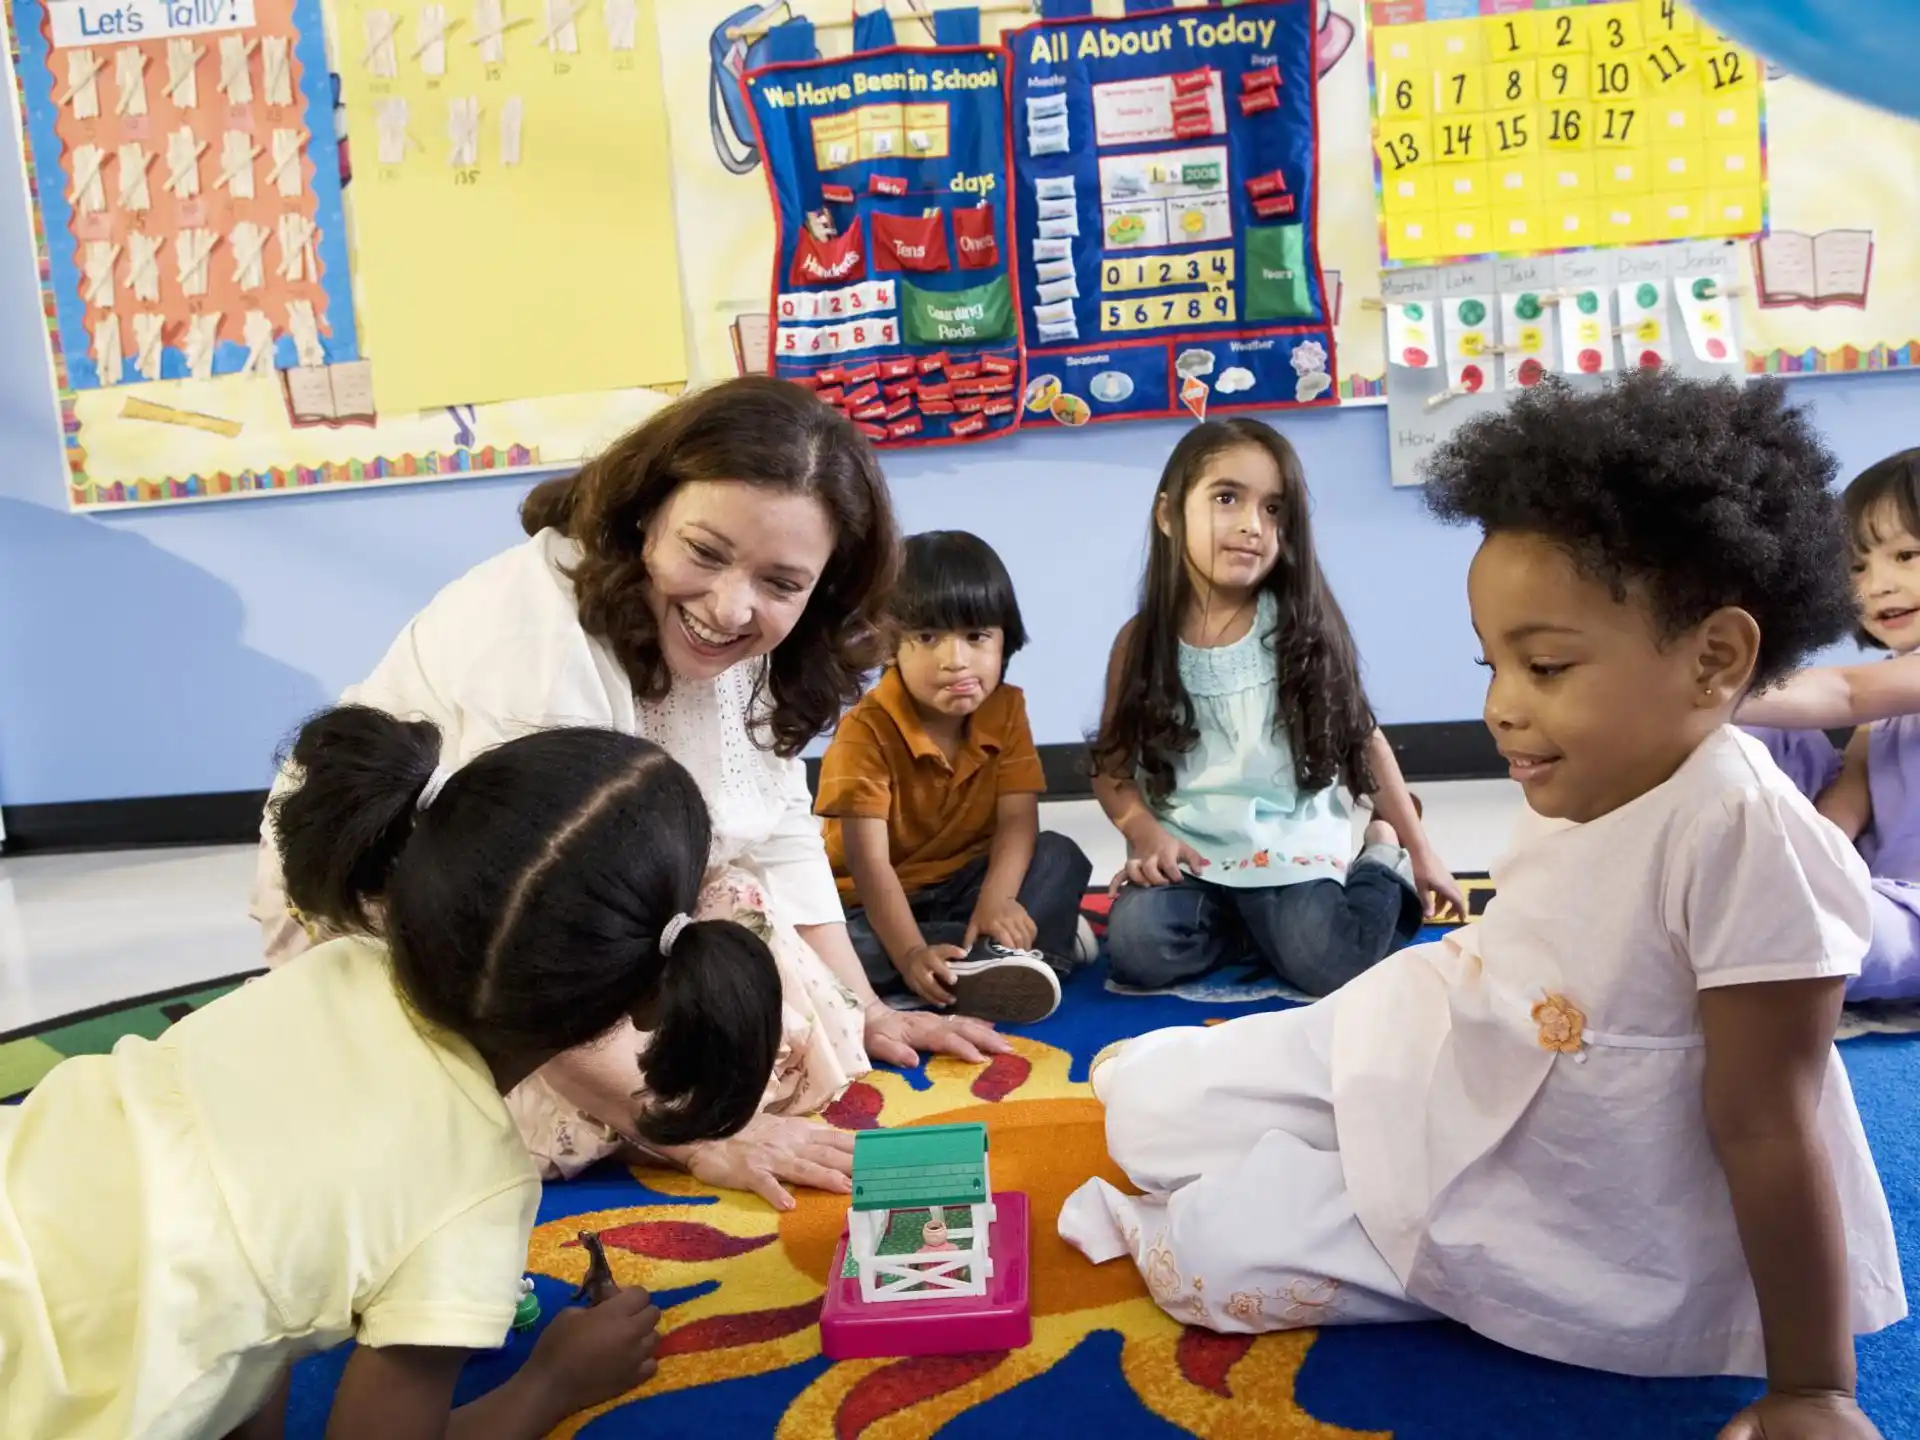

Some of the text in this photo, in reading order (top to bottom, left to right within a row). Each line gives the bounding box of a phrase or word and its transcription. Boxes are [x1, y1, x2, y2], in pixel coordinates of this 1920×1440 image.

[78, 0, 237, 36] Let's Tally!
[1504, 0, 1675, 52] 1 2 3 4
[1030, 13, 1276, 64] All About Today
[763, 67, 998, 108] We Have Been in School
[1395, 44, 1744, 110] 6 7 8 9 10 11 12
[1385, 109, 1635, 171] 13 14 15 16 17
[950, 171, 995, 198] days
[893, 239, 926, 258] Tens
[959, 234, 995, 253] Ones
[1107, 256, 1227, 285] 0 1 2 3 4
[1262, 266, 1294, 280] Years
[782, 288, 889, 316] 0 1 2 3 4
[927, 302, 984, 320] Counting
[1109, 295, 1228, 327] 5 6 7 8 9
[785, 325, 894, 350] 5 6 7 8 9
[938, 323, 976, 340] Rods
[1230, 338, 1275, 352] Weather
[1398, 430, 1437, 448] How
